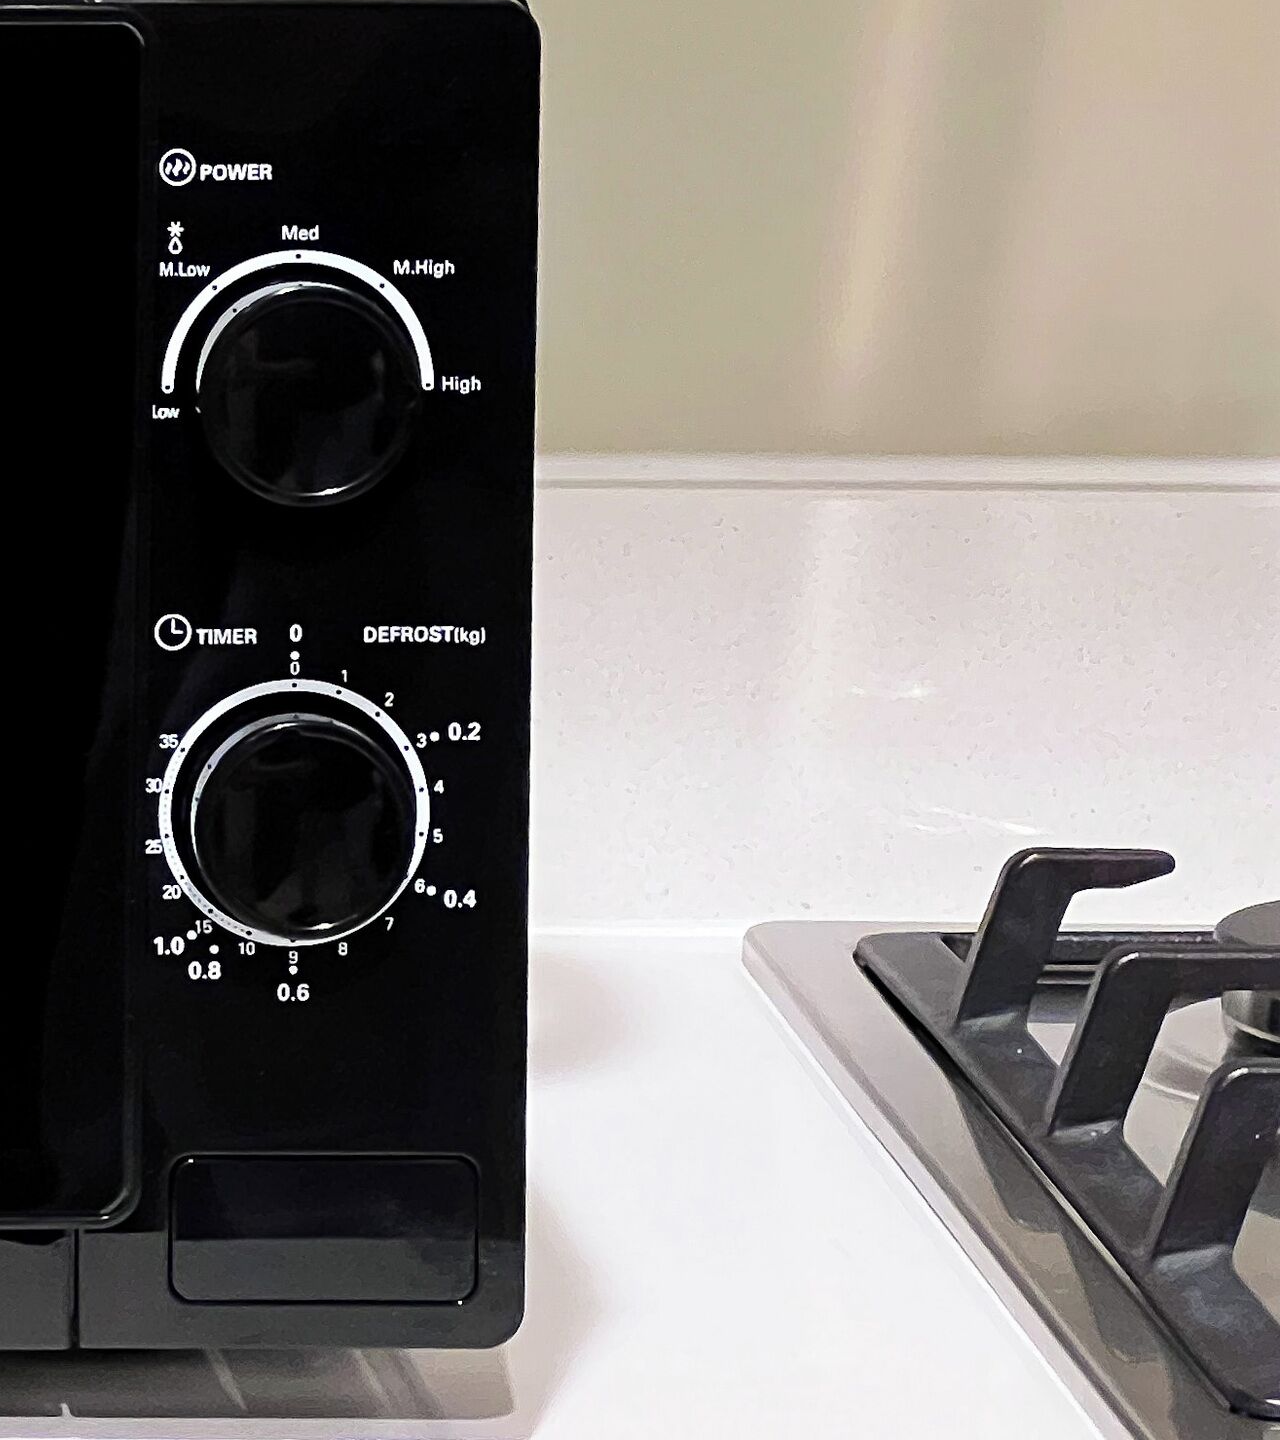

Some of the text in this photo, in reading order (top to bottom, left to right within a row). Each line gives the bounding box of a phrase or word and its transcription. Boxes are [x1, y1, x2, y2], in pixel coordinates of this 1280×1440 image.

[200, 164, 272, 181] POWER
[281, 224, 320, 241] Med
[159, 262, 210, 277] M.Low
[393, 259, 455, 278] M.High
[441, 375, 482, 395] High
[151, 404, 181, 420] Low
[196, 628, 257, 645] TIMER
[289, 623, 303, 643] 0
[364, 625, 485, 646] DEFROST(kg)
[289, 661, 301, 676] 0
[341, 669, 348, 683] 1
[384, 691, 395, 708] 2
[447, 721, 482, 742] 0.2
[158, 733, 179, 749] 35
[415, 732, 428, 749] 3
[145, 778, 163, 794] 30
[433, 779, 445, 794] 4
[432, 827, 444, 844] 5
[144, 839, 163, 854] 25
[162, 884, 182, 900] 20
[414, 878, 426, 894] 6
[443, 889, 477, 909] 0.4
[195, 918, 213, 934] 15
[384, 916, 395, 931] 7
[153, 935, 186, 956] 1.0
[237, 941, 256, 956] 10
[337, 941, 348, 957] 8
[288, 950, 299, 965] 9
[187, 960, 222, 981] 0.8
[276, 982, 310, 1002] 0.6
